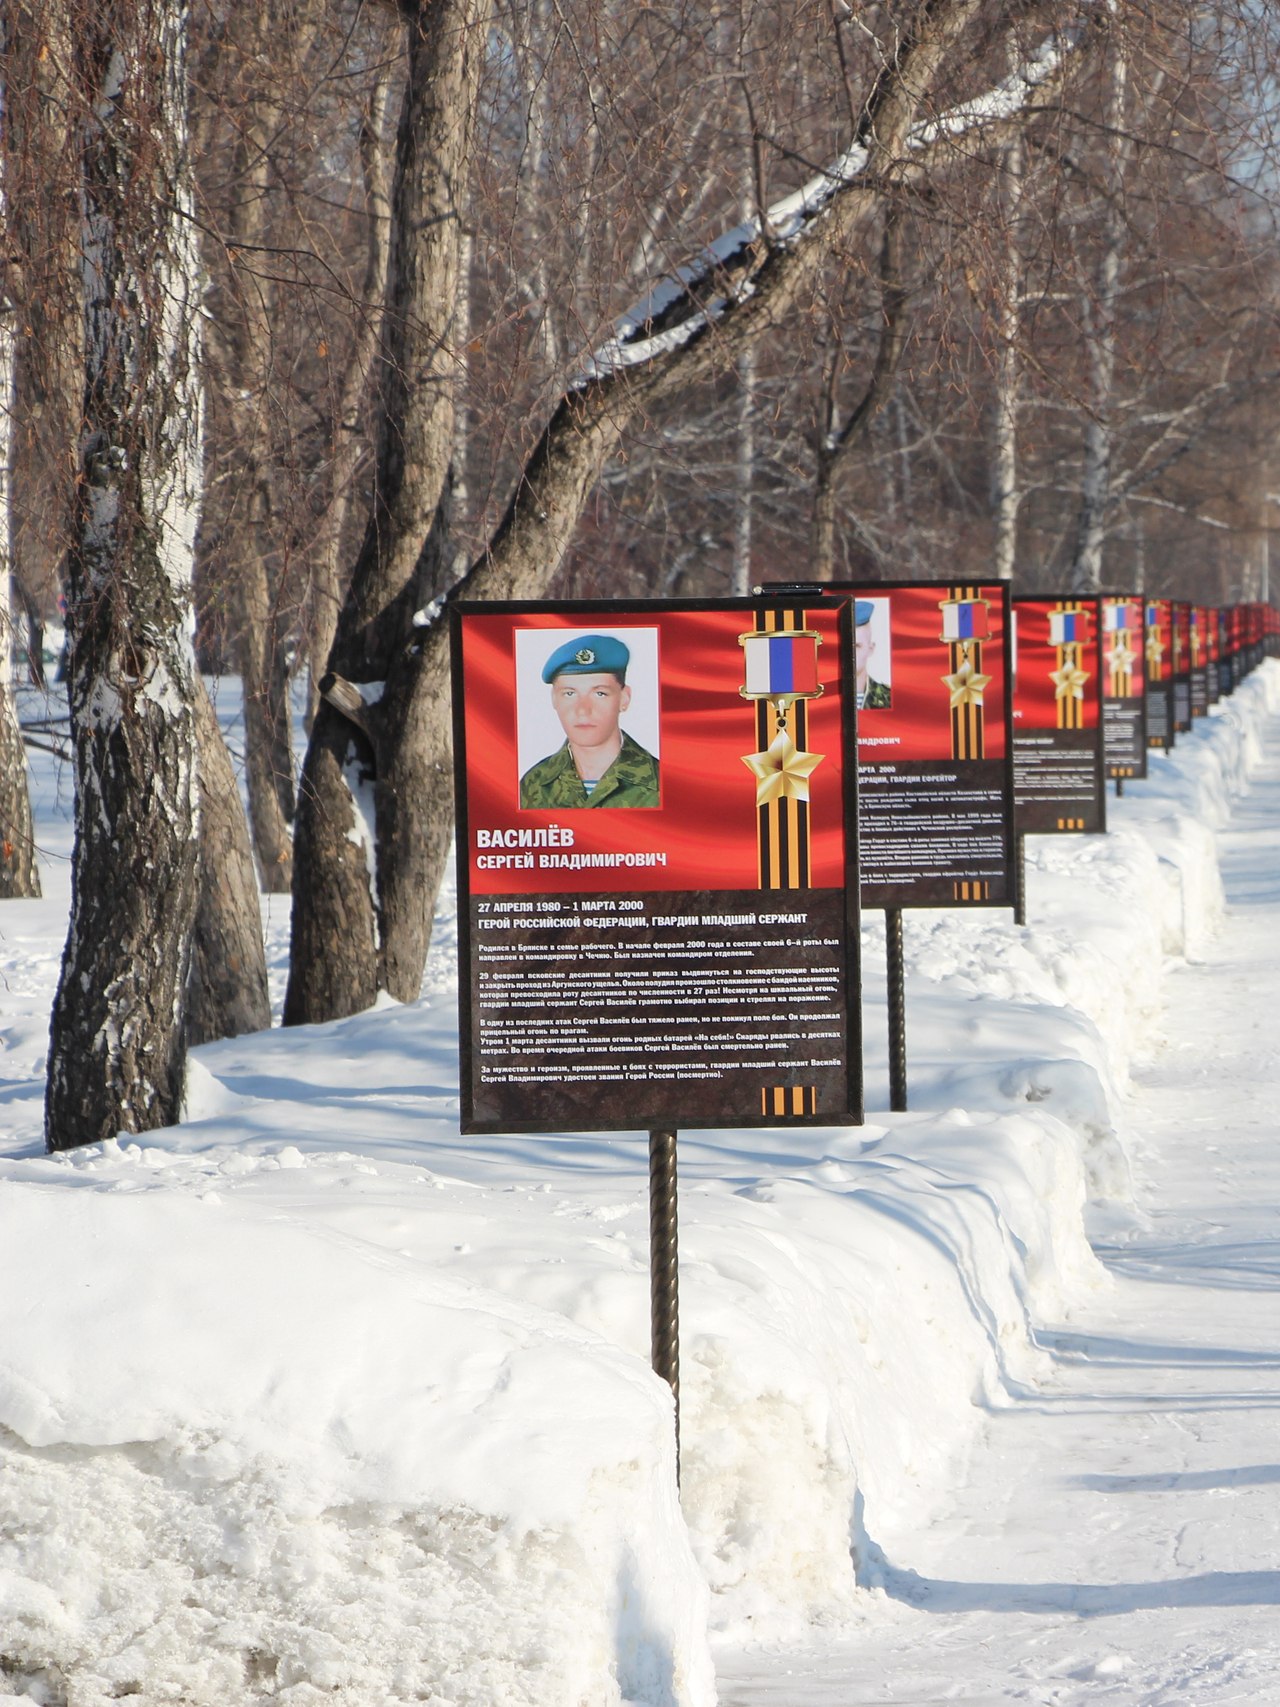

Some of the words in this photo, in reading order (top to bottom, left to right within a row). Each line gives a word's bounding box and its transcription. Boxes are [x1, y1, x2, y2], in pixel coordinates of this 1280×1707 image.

[477, 824, 574, 847] ВАСИЛЁВ
[477, 851, 534, 868] СЕРГЕЙ
[540, 853, 666, 869] ВЛАДИМИРОВИЧ
[478, 903, 490, 912] 27
[494, 902, 533, 912] АПРЕЛЯ
[537, 901, 561, 911] 1980
[573, 901, 578, 911] 1
[582, 900, 616, 910] МАРТА
[619, 900, 643, 910] 2000
[478, 917, 510, 929] ГЕРОЙ
[513, 915, 580, 928] РОССИЙСКОЙ
[583, 916, 649, 928] ФЕДЕРАЦИИ,
[652, 915, 699, 927] ГВАРДИИ
[702, 912, 756, 926] МЛАДШИЙ
[758, 913, 807, 924] СЕРЖАНТ
[478, 944, 510, 953] Родился
[518, 943, 548, 953] Брянске
[581, 942, 616, 952] рабочего.
[618, 941, 624, 950] В
[653, 940, 684, 951] февраля
[687, 939, 706, 948] 2000
[763, 938, 784, 947] своей
[803, 939, 822, 948] роты
[824, 937, 839, 946] был
[479, 954, 517, 963] направлен
[526, 953, 576, 962] командировку
[614, 950, 630, 959] Был
[668, 950, 712, 959] командиром
[714, 950, 754, 958] отделения.
[479, 972, 489, 980] 29
[492, 971, 524, 982] февраля
[569, 971, 611, 980] десантники
[614, 970, 649, 979] получили
[652, 970, 678, 979] приказ
[746, 968, 807, 976] господствующие
[485, 982, 515, 991] закрыть
[516, 982, 542, 990] проход
[552, 979, 592, 990] Аргунского
[592, 980, 621, 989] ущелья.
[622, 978, 644, 987] Около
[645, 979, 674, 988] полудня
[676, 978, 715, 987] произошло
[772, 975, 797, 985] бандой
[480, 992, 508, 1000] которая
[510, 991, 561, 1000] превосходила
[563, 990, 578, 999] роту
[581, 989, 626, 998] десантников
[694, 986, 702, 995] 27
[705, 986, 720, 997] раз!
[723, 985, 758, 996] Несмотря
[814, 985, 837, 994] огонь,
[480, 1001, 509, 1010] гвардии
[511, 998, 545, 1009] младший
[547, 1000, 577, 1009] сержант
[579, 997, 604, 1008] Сергей
[606, 997, 636, 1006] Василёв
[638, 998, 672, 1007] грамотно
[674, 996, 706, 1006] выбирал
[708, 997, 738, 1005] позиции
[747, 996, 776, 1005] стрелял
[788, 995, 831, 1004] поражение.
[480, 1018, 486, 1027] В
[486, 1020, 504, 1028] одну
[516, 1019, 554, 1027] последних
[573, 1016, 598, 1027] Сергей
[600, 1015, 630, 1025] Василёв
[631, 1015, 646, 1024] был
[676, 1016, 700, 1025] ранен,
[722, 1015, 752, 1024] покинул
[772, 1012, 788, 1021] боя.
[788, 1012, 798, 1021] Он
[800, 1013, 840, 1022] продолжал
[480, 1027, 525, 1038] прицельный
[560, 1028, 588, 1037] врагам.
[481, 1037, 503, 1047] Утром
[505, 1036, 509, 1045] 1
[512, 1038, 534, 1046] марта
[536, 1037, 577, 1046] десантники
[634, 1035, 662, 1044] родных
[664, 1033, 692, 1043] батарей
[770, 1033, 800, 1042] рвались
[808, 1032, 840, 1040] десятках
[481, 1047, 509, 1056] метрах.
[511, 1045, 520, 1054] Во
[522, 1047, 544, 1056] время
[546, 1044, 584, 1055] очередной
[609, 1043, 642, 1052] боевиков
[644, 1042, 670, 1053] Сергей
[672, 1042, 702, 1051] Василёв
[704, 1042, 719, 1050] был
[721, 1042, 763, 1052] смертельно
[765, 1042, 789, 1051] ранен.
[481, 1065, 490, 1073] За
[493, 1066, 528, 1075] мужество
[538, 1065, 569, 1074] героизм,
[572, 1064, 620, 1073] проявленные
[629, 1062, 646, 1071] боях
[656, 1062, 708, 1072] террористами,
[710, 1062, 740, 1071] гвардии
[742, 1059, 776, 1069] младший
[778, 1060, 808, 1069] сержант
[811, 1058, 841, 1067] Василёв
[481, 1073, 506, 1084] Сергей
[508, 1073, 562, 1084] Владимирович
[564, 1074, 596, 1083] удостоен
[626, 1071, 647, 1082] Герой
[649, 1071, 674, 1080] России
